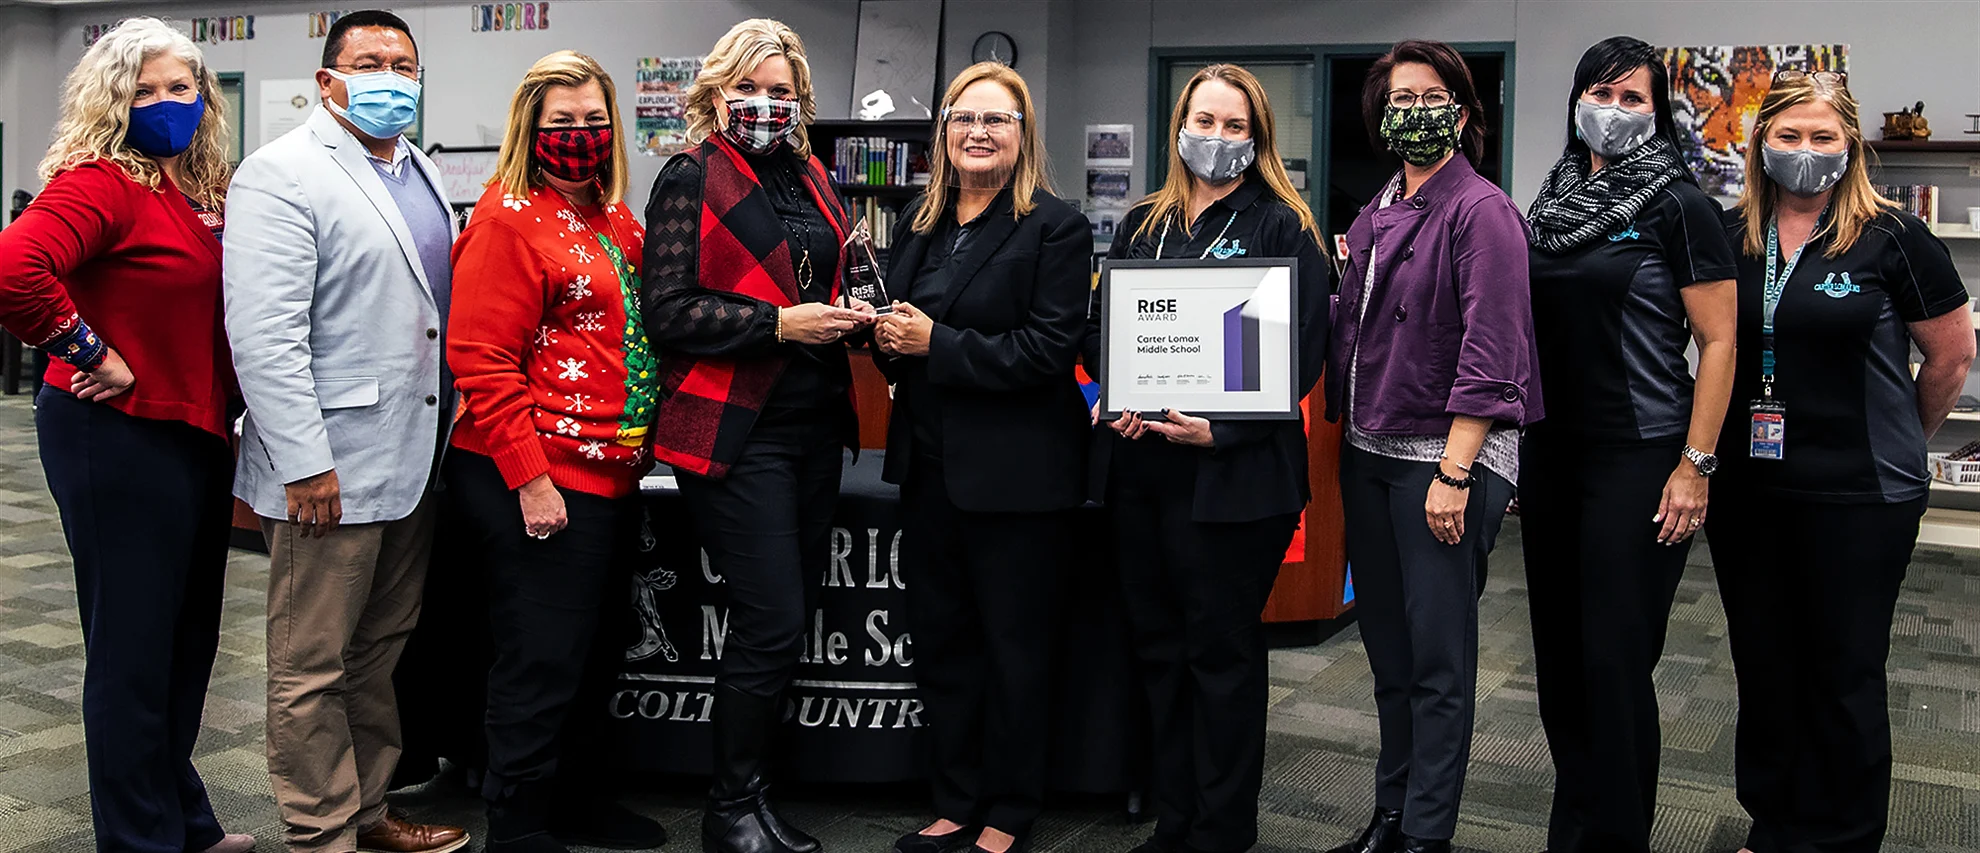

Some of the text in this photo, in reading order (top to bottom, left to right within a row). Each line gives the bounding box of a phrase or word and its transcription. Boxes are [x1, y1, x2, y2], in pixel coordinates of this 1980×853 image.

[471, 2, 549, 32] INSPIRE
[191, 15, 256, 45] INQUIRE
[851, 284, 875, 296] RISE
[1138, 299, 1177, 313] RISE
[1137, 313, 1177, 321] AWARD
[1136, 335, 1200, 343] Carter Lomax
[1136, 345, 1201, 353] Middle School
[701, 605, 848, 665] Mle
